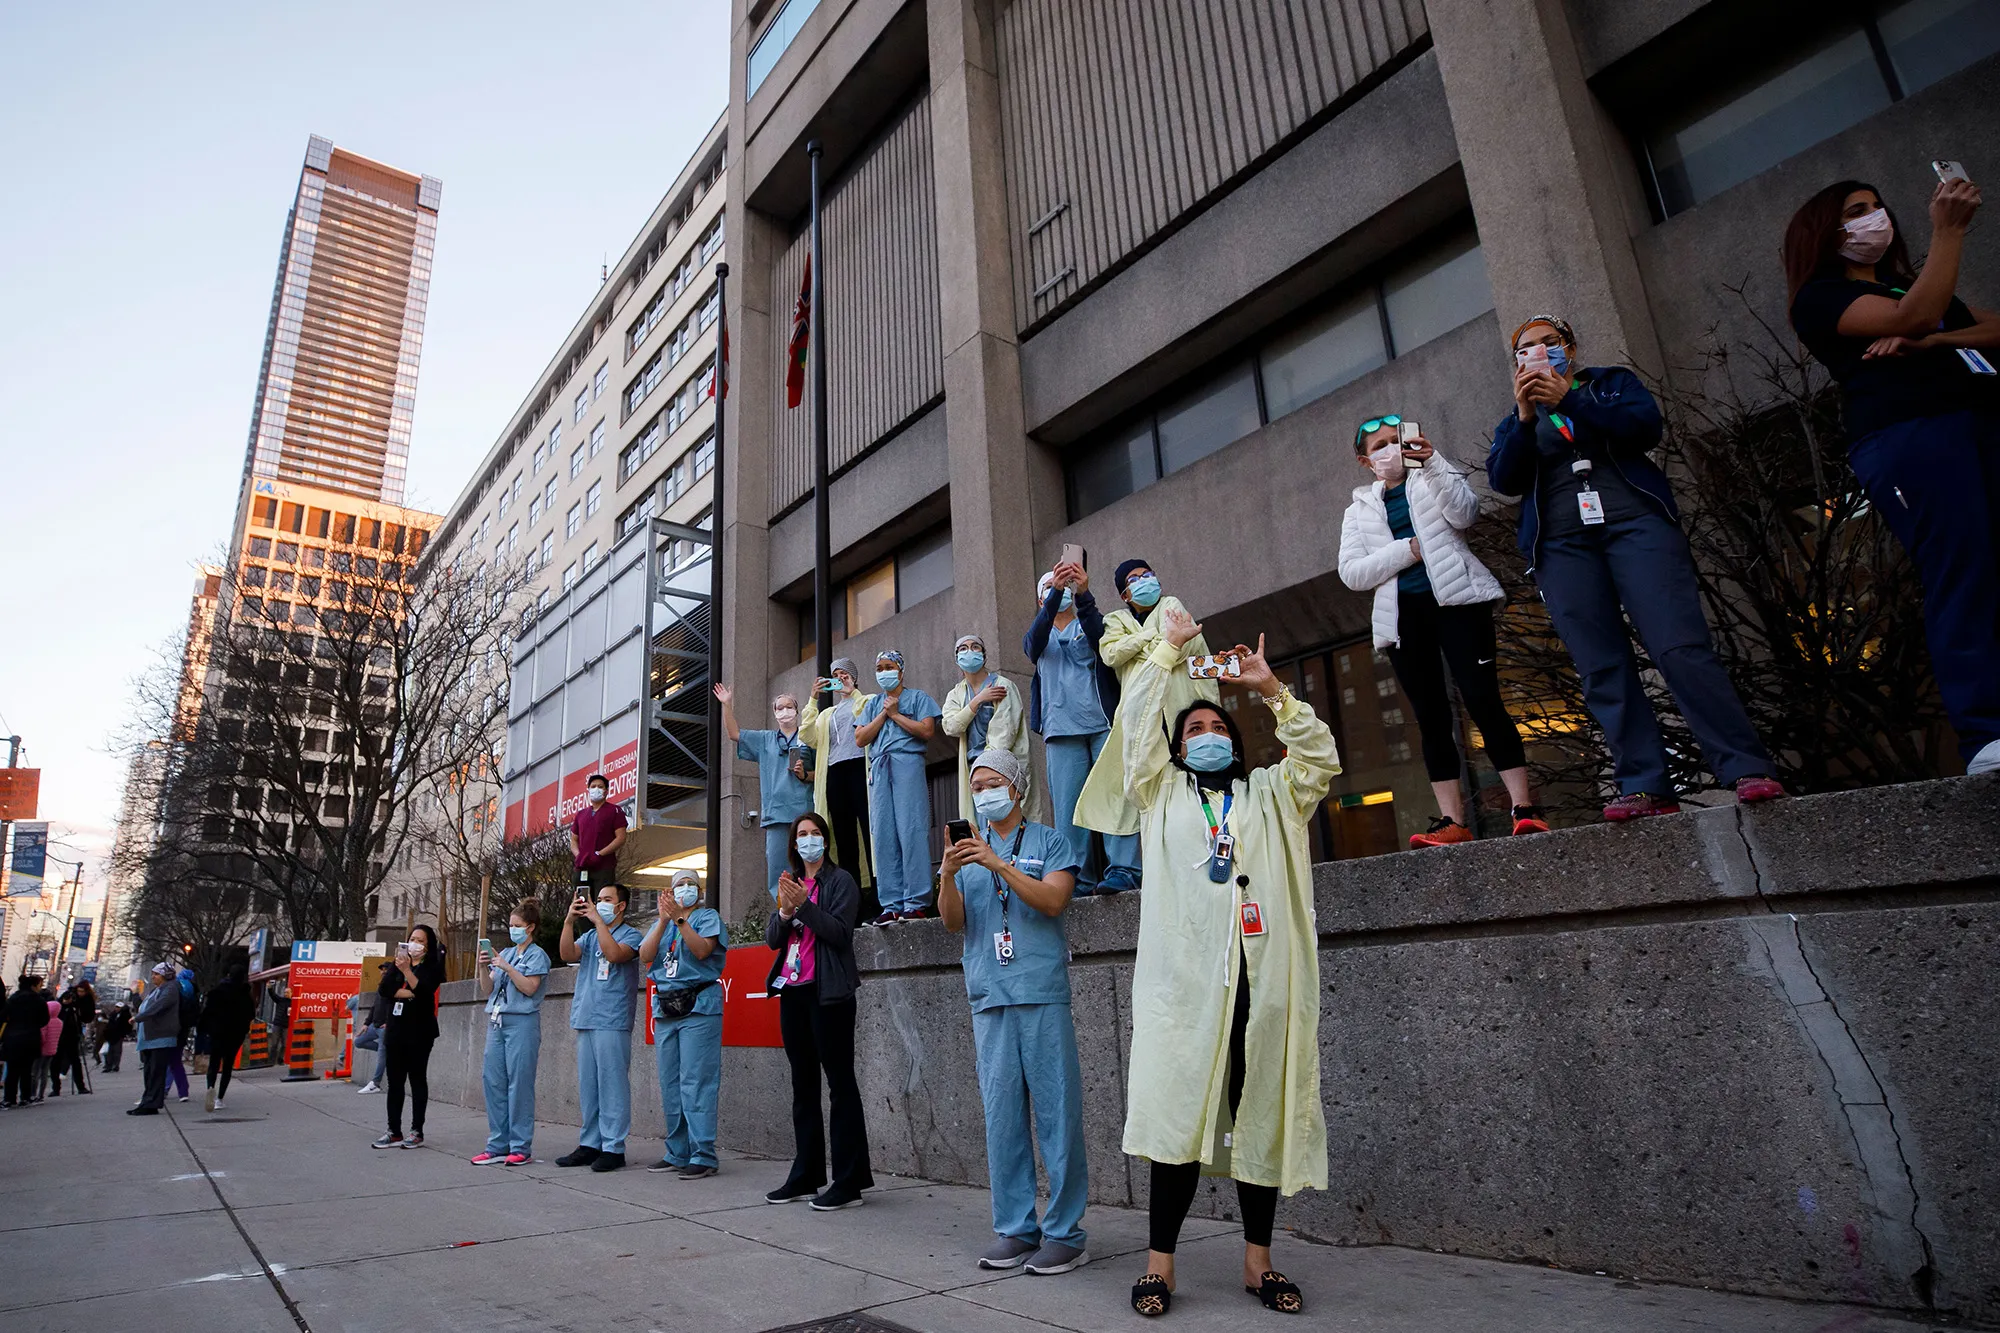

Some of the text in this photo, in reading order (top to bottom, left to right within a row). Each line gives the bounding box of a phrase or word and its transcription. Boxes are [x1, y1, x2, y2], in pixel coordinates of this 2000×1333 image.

[548, 792, 593, 824] EERGEN
[605, 767, 637, 800] ENTRE
[297, 943, 313, 959] H
[299, 992, 352, 1002] mergency
[300, 1004, 328, 1013] entre
